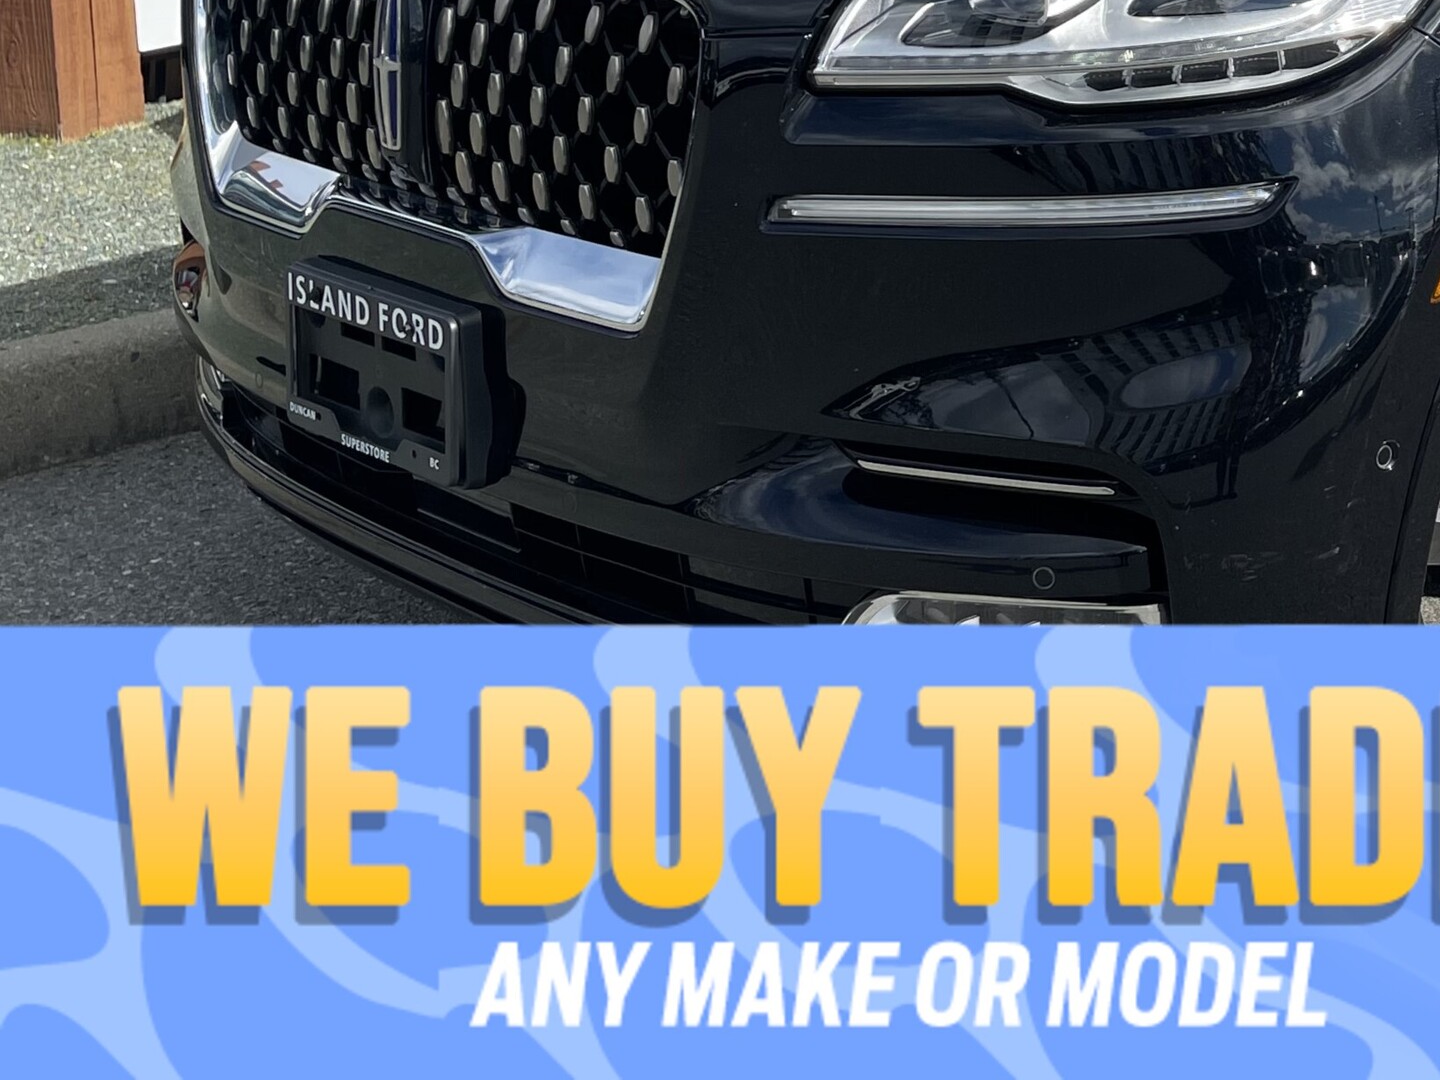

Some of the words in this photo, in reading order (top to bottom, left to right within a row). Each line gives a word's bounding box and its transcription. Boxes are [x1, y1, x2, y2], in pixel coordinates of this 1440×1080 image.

[287, 272, 370, 326] ISLAND
[378, 302, 443, 350] FORD
[289, 401, 317, 421] DUNCAN
[340, 433, 390, 463] SUPERSTORE
[429, 456, 440, 471] BC
